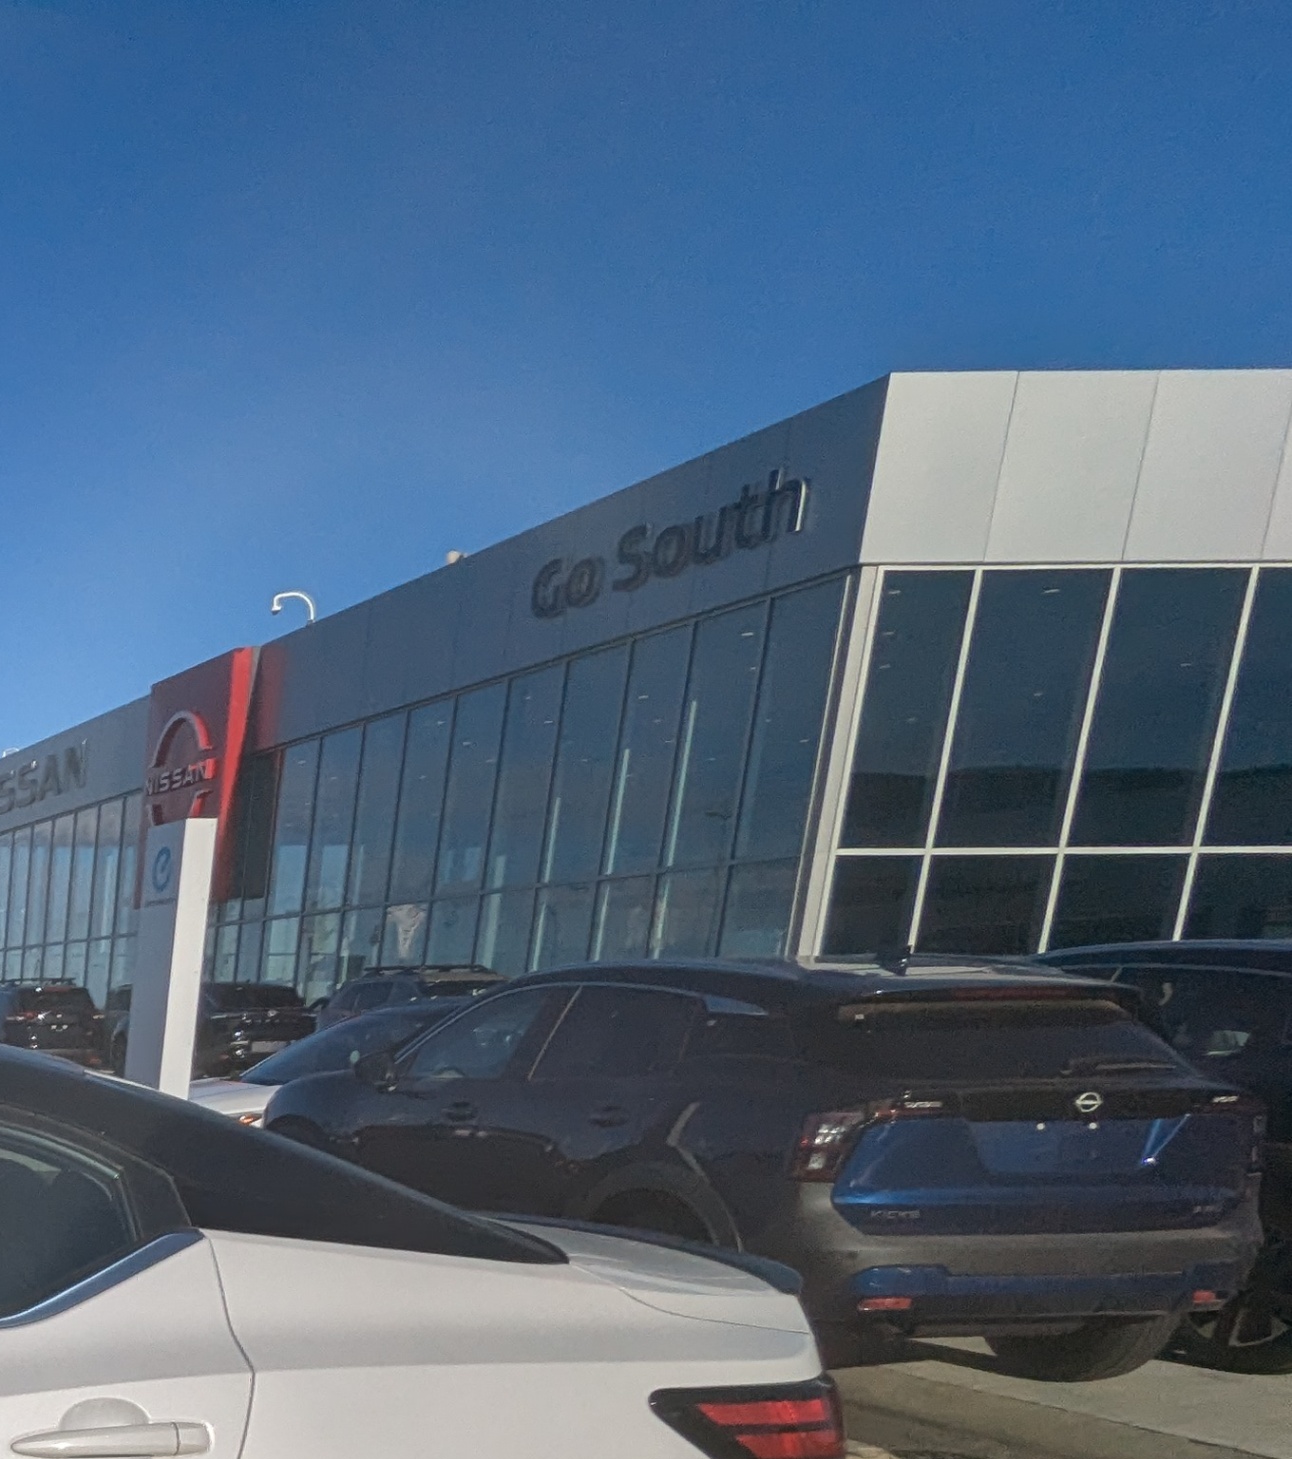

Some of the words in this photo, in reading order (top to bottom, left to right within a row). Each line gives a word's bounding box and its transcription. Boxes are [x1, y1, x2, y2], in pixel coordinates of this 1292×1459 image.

[531, 557, 603, 619] Go
[613, 465, 810, 592] South
[145, 757, 216, 796] NISSAN
